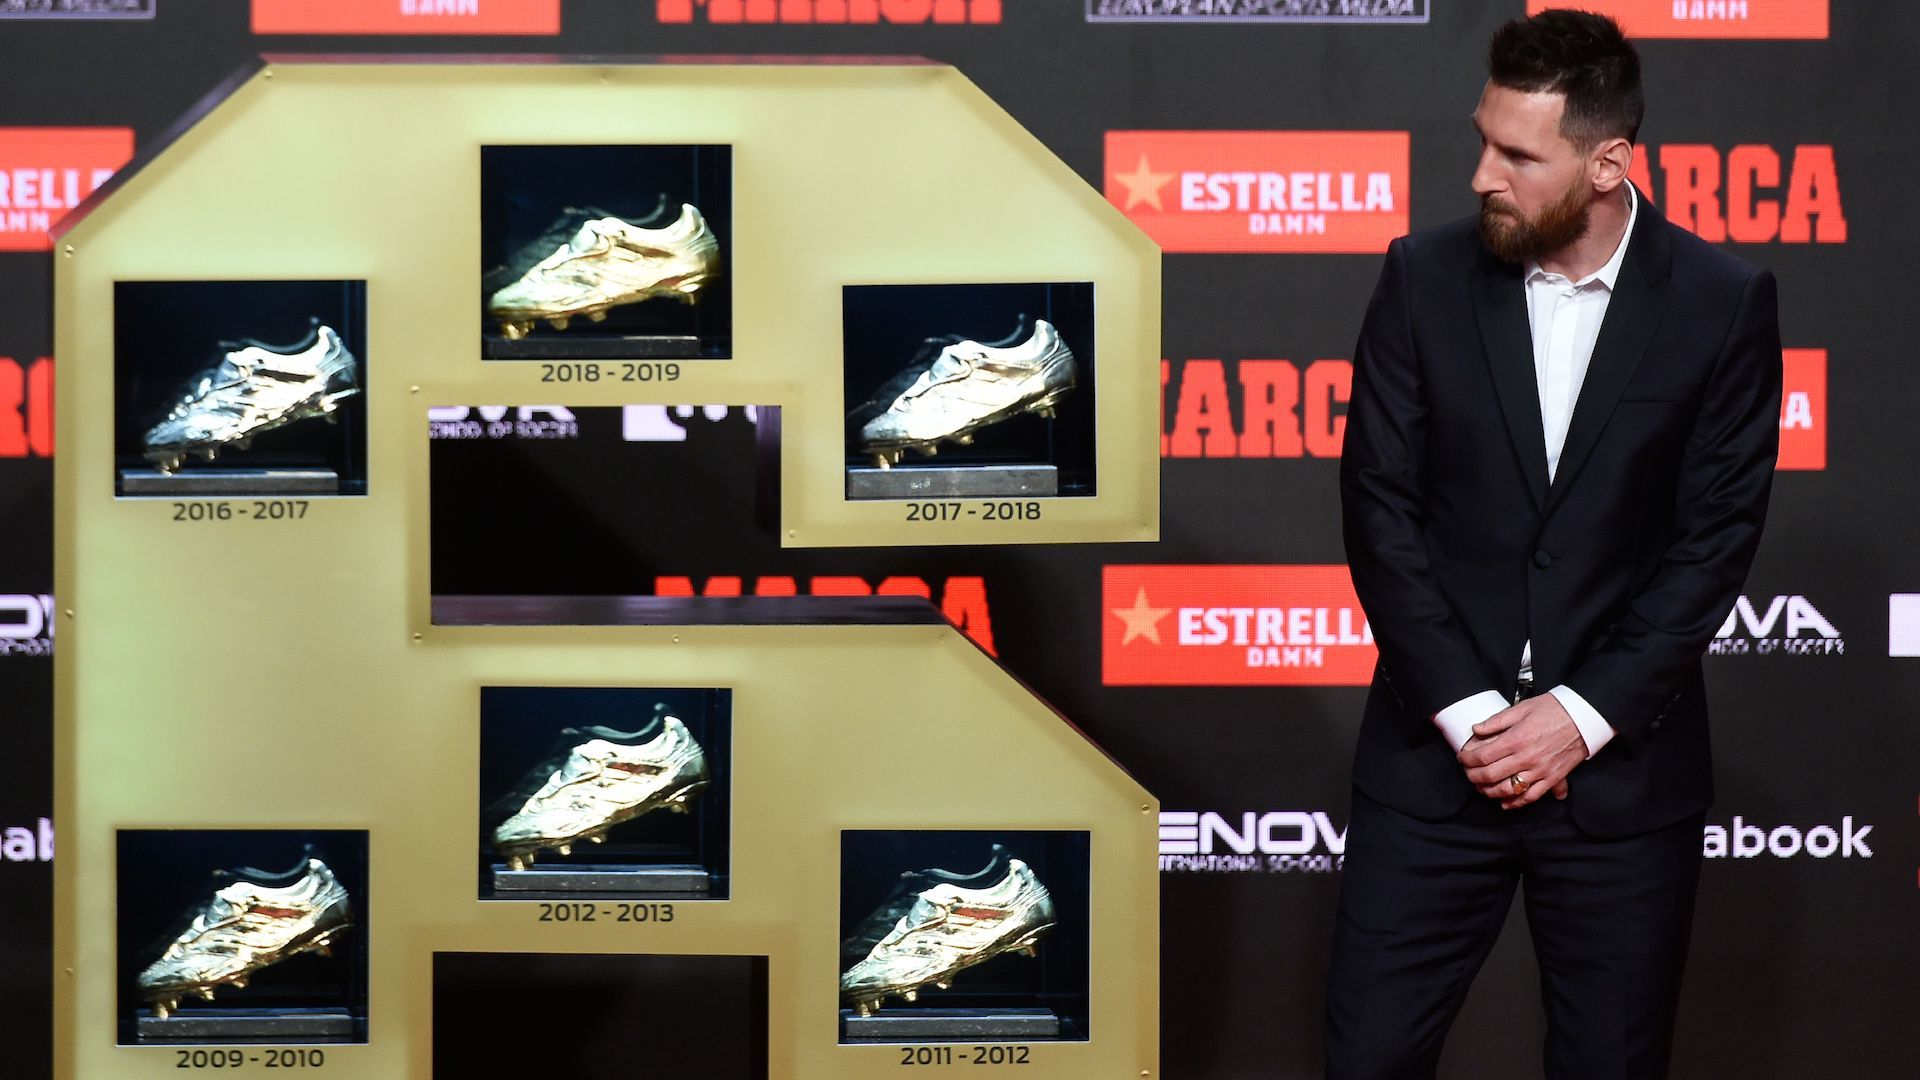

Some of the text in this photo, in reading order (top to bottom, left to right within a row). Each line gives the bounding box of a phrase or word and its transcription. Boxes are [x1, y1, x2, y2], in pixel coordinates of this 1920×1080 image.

[1672, 0, 1748, 20] DAMM
[1181, 172, 1393, 211] ESTRELLA
[1627, 144, 1848, 243] RCA
[1249, 214, 1326, 234] DAMM
[541, 364, 600, 382] 2018
[621, 363, 681, 381] 2019
[1161, 359, 1354, 458] ARC
[173, 502, 232, 521] 2016
[253, 501, 309, 519] 2017
[906, 503, 962, 521] 2017
[982, 502, 1041, 520] 2018
[1247, 647, 1324, 667] DAMM
[1159, 812, 1349, 854] ENOV
[1703, 816, 1874, 858] abook
[539, 904, 596, 922] 2012
[617, 904, 674, 922] 2013
[176, 1050, 244, 1068] 2009
[265, 1049, 324, 1067] 2010
[901, 1047, 951, 1065] 2011
[973, 1046, 1030, 1064] 2012
